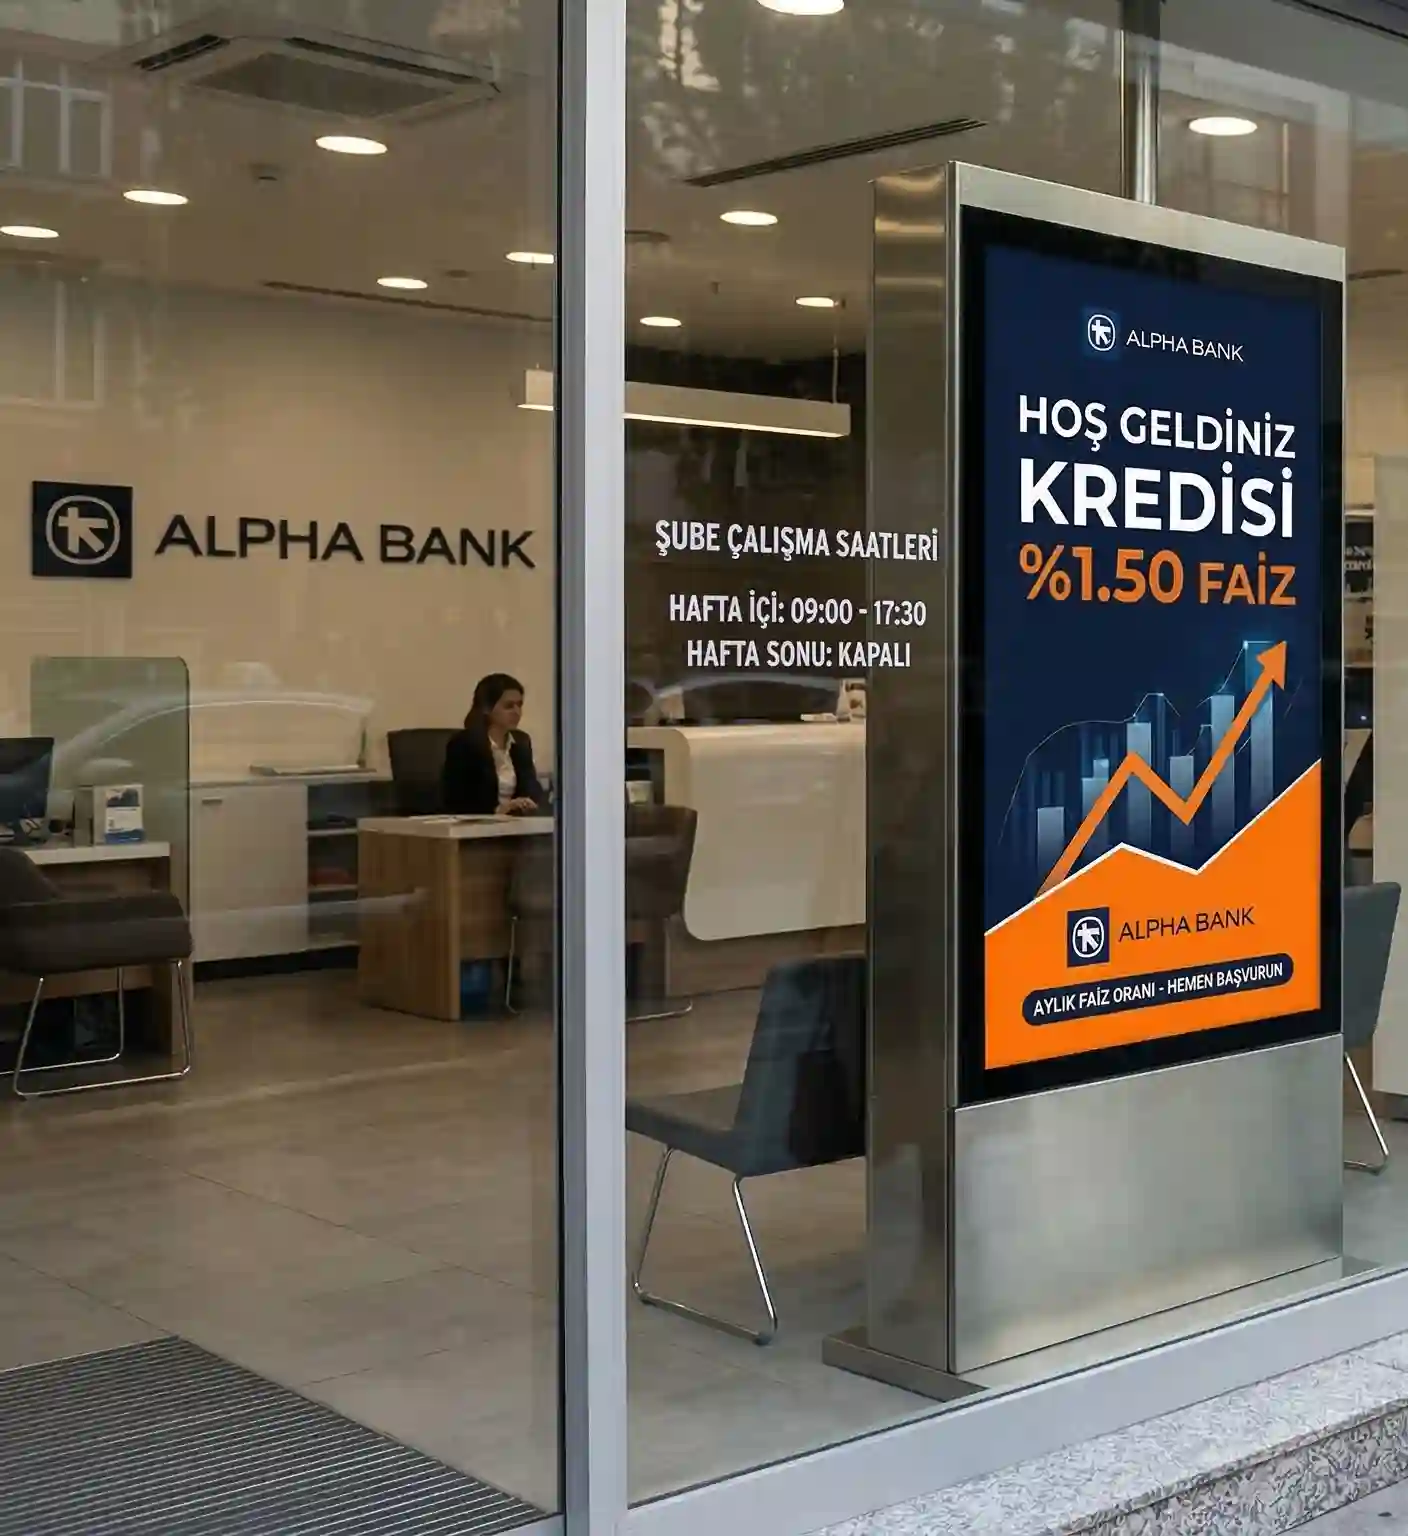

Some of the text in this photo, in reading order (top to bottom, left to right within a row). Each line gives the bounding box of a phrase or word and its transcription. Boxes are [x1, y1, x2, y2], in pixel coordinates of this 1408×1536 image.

[1126, 329, 1244, 362] ALPHA BANK
[1019, 394, 1296, 459] HOŞ GELDİNİZ
[1019, 457, 1293, 538] KREDİSİ
[155, 514, 536, 568] ALPHA BANK
[655, 519, 938, 561] ŞUBE ÇALIŞMA SAATLERİ
[1019, 543, 1184, 604] %1.50
[1199, 551, 1297, 606] FAİZ
[669, 594, 742, 623] HAFTA
[749, 590, 785, 629] İÇİ:
[790, 598, 852, 625] 09:00
[874, 601, 927, 626] 17:30
[687, 640, 911, 667] HAFTA SONU: KAPALI
[1118, 906, 1255, 943] ALPHA BANK
[1033, 994, 1076, 1017] AYLIK
[1079, 986, 1110, 1009] FAİZ
[1113, 983, 1155, 1003] ORANI
[1167, 973, 1214, 995] HEMEN
[1217, 962, 1283, 988] BAŞVURUN
